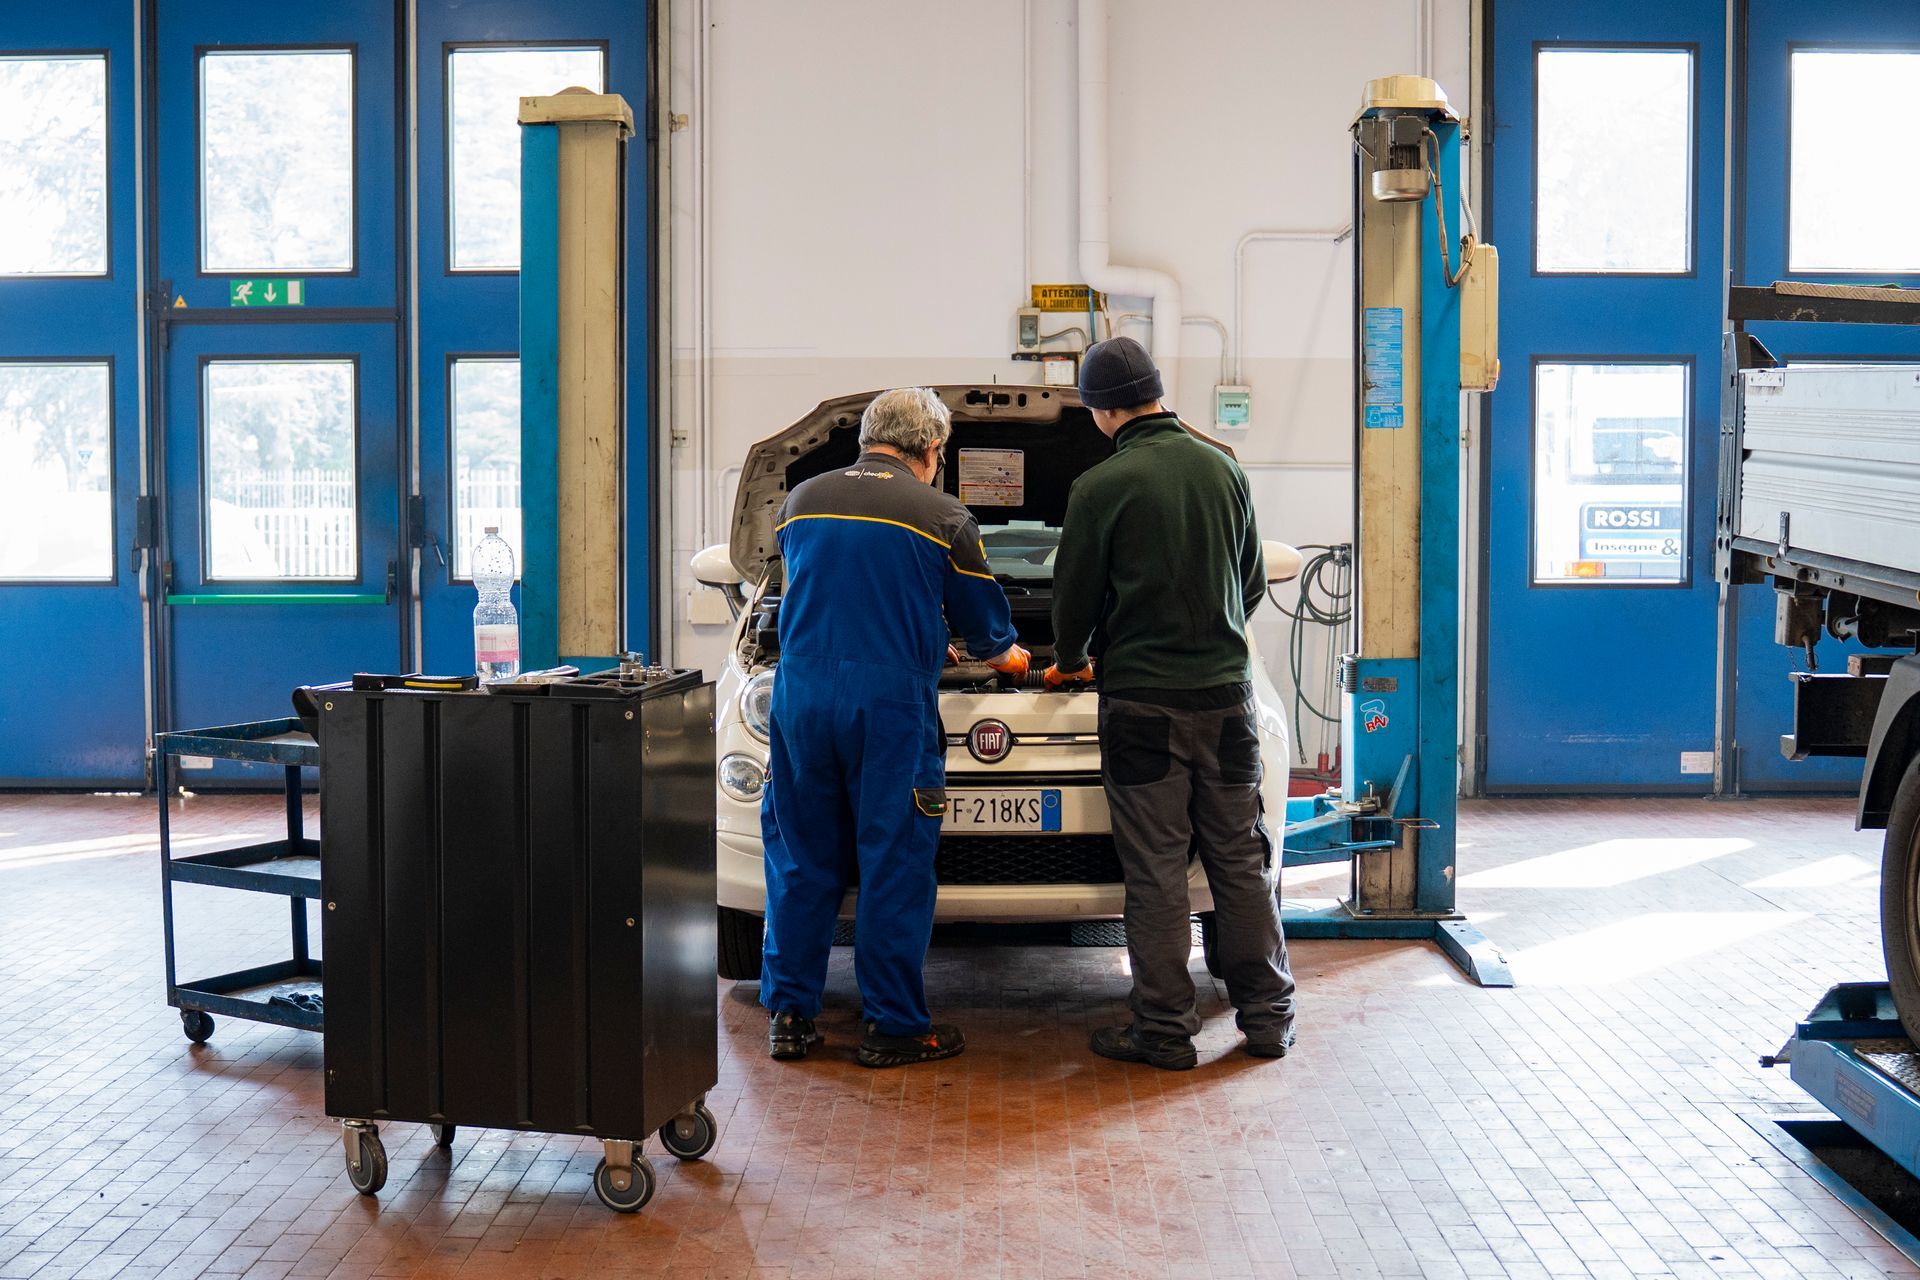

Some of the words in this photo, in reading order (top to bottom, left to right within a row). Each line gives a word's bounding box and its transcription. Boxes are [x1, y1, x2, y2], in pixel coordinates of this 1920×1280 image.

[1594, 510, 1660, 527] ROSSI
[1594, 542, 1657, 553] Insegne
[1661, 538, 1679, 556] &
[980, 732, 1001, 750] FIAT
